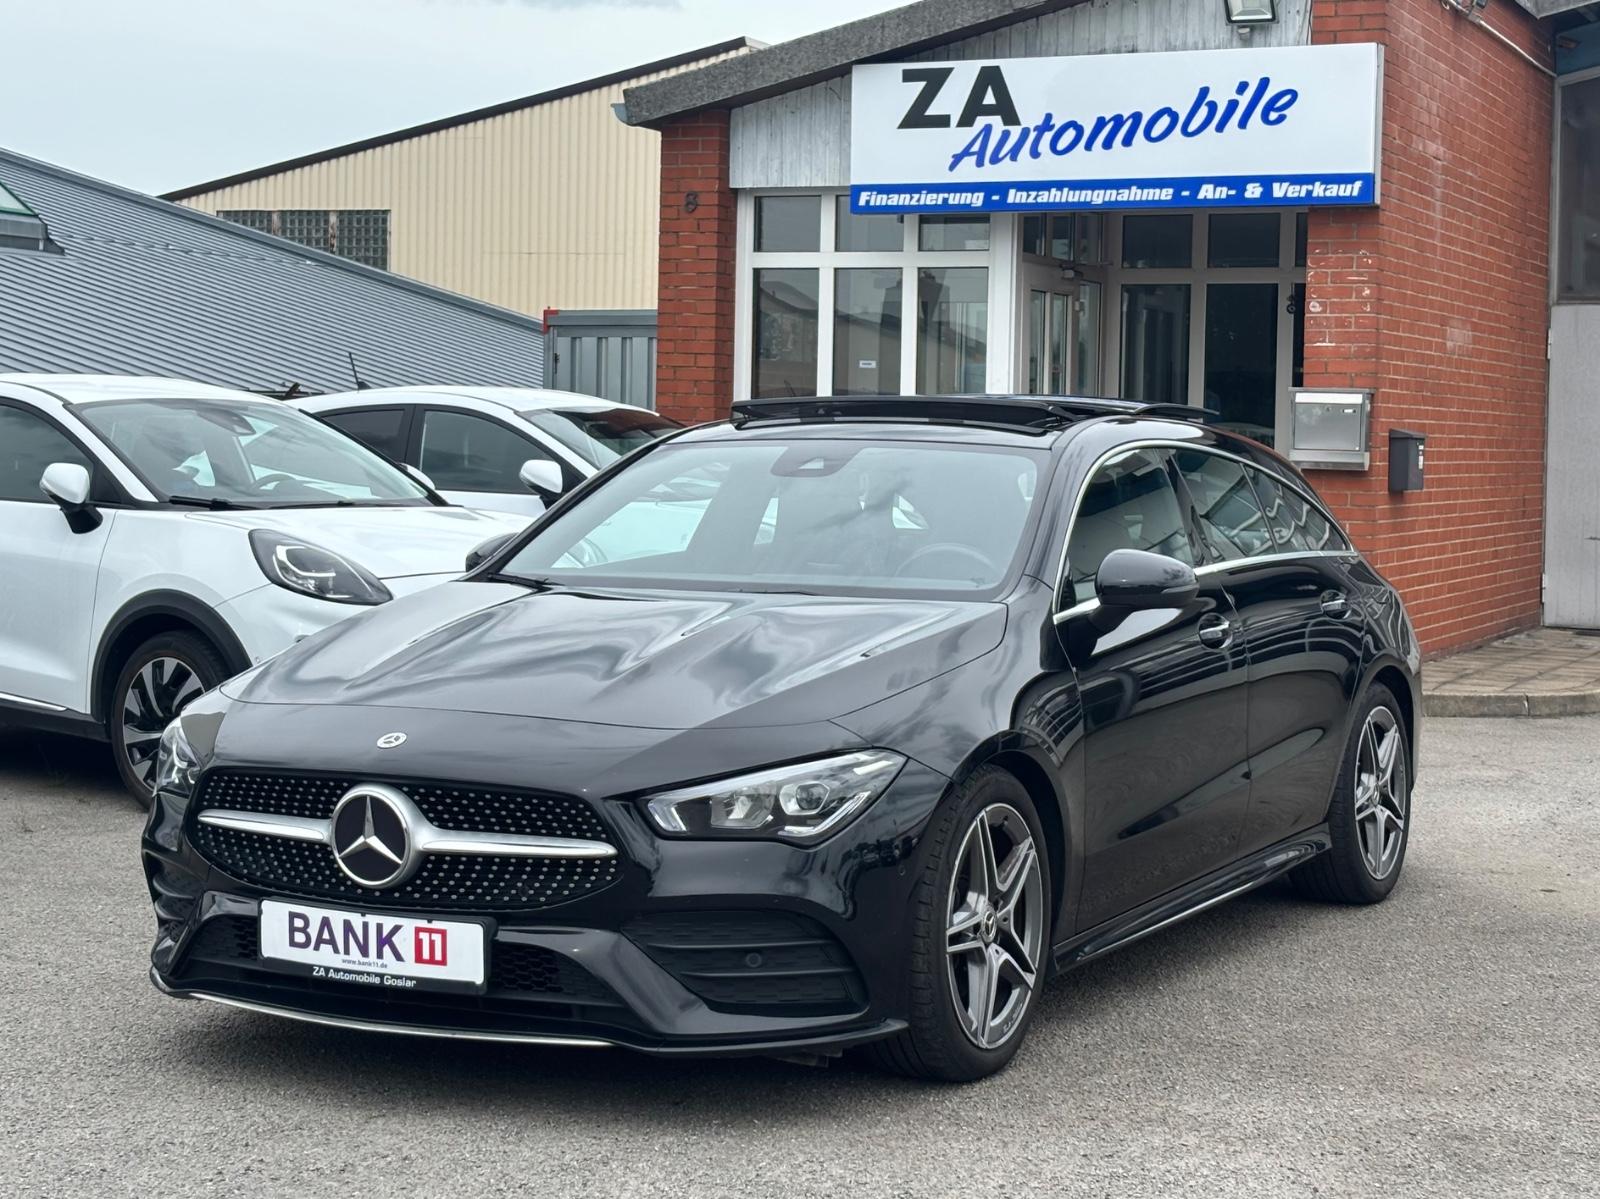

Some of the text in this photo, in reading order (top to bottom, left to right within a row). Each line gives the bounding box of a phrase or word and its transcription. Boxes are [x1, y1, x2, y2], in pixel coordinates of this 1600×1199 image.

[897, 66, 1021, 129] ZA
[948, 76, 1299, 172] Automobile
[858, 190, 985, 208] Finanzierung
[1006, 185, 1174, 206] Inzahlungnahme
[1197, 183, 1236, 200] An-
[1244, 182, 1264, 199] &
[1272, 180, 1364, 198] Verkauf
[288, 910, 443, 962] BANK 11
[312, 966, 417, 988] ZA Automobile Goslar
[341, 958, 388, 969] www.bank11.de
